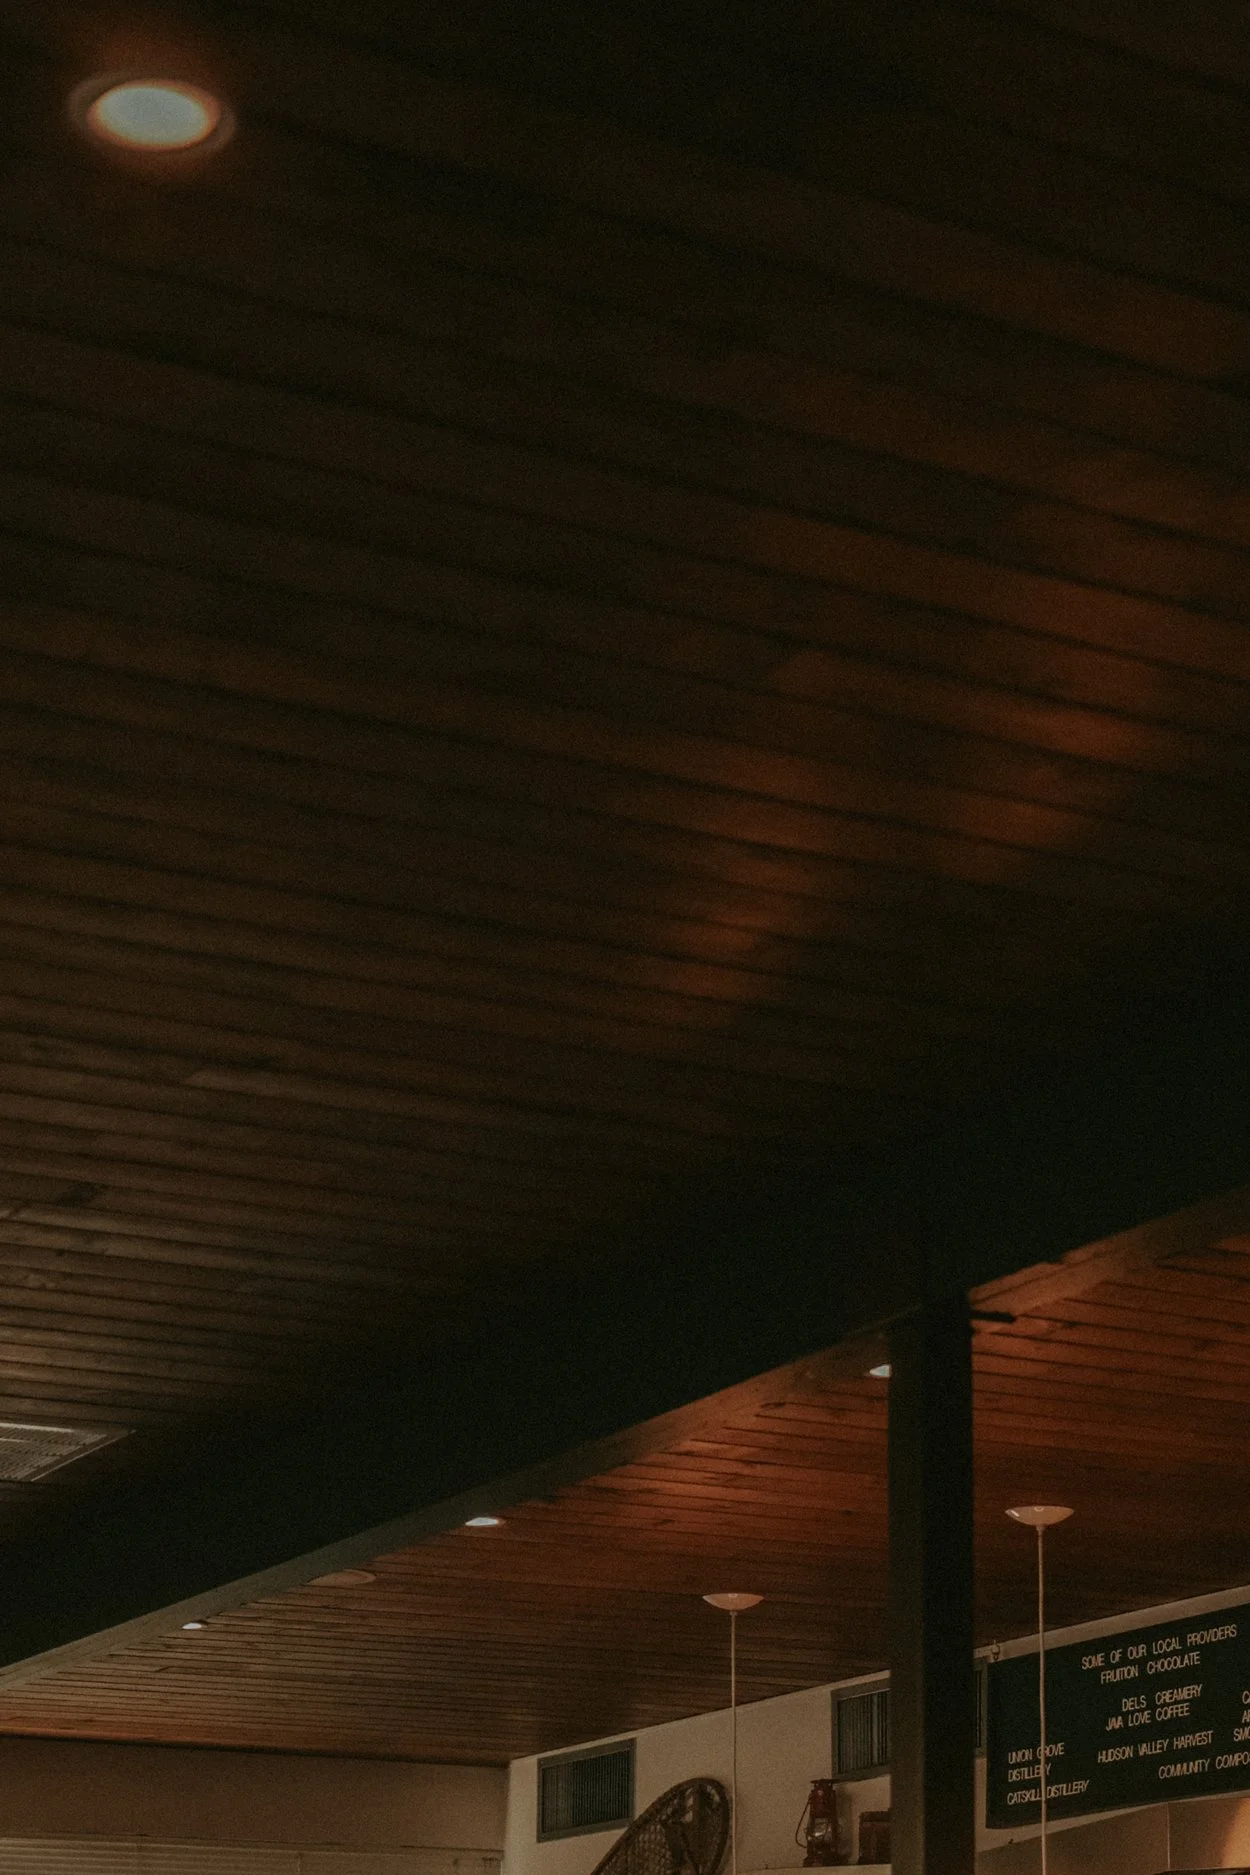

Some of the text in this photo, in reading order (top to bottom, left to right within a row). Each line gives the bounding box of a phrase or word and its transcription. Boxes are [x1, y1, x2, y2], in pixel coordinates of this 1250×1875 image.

[1081, 1624, 1237, 1670] SOME OF OUR LOCAL PROVIDERS
[1100, 1651, 1200, 1684] FRUITION CHOCOLATE
[1122, 1684, 1203, 1712] DELS CREAMERY
[1105, 1703, 1190, 1731] JAVA LOVE COFFEE
[1008, 1749, 1032, 1764] UNION
[1097, 1730, 1214, 1763] HUDSON VALLEY HARVEST
[1008, 1762, 1051, 1782] DISTILLEY
[1158, 1758, 1210, 1779] COMMUNITY
[1007, 1780, 1089, 1805] CATSKILL DISTILLERY
